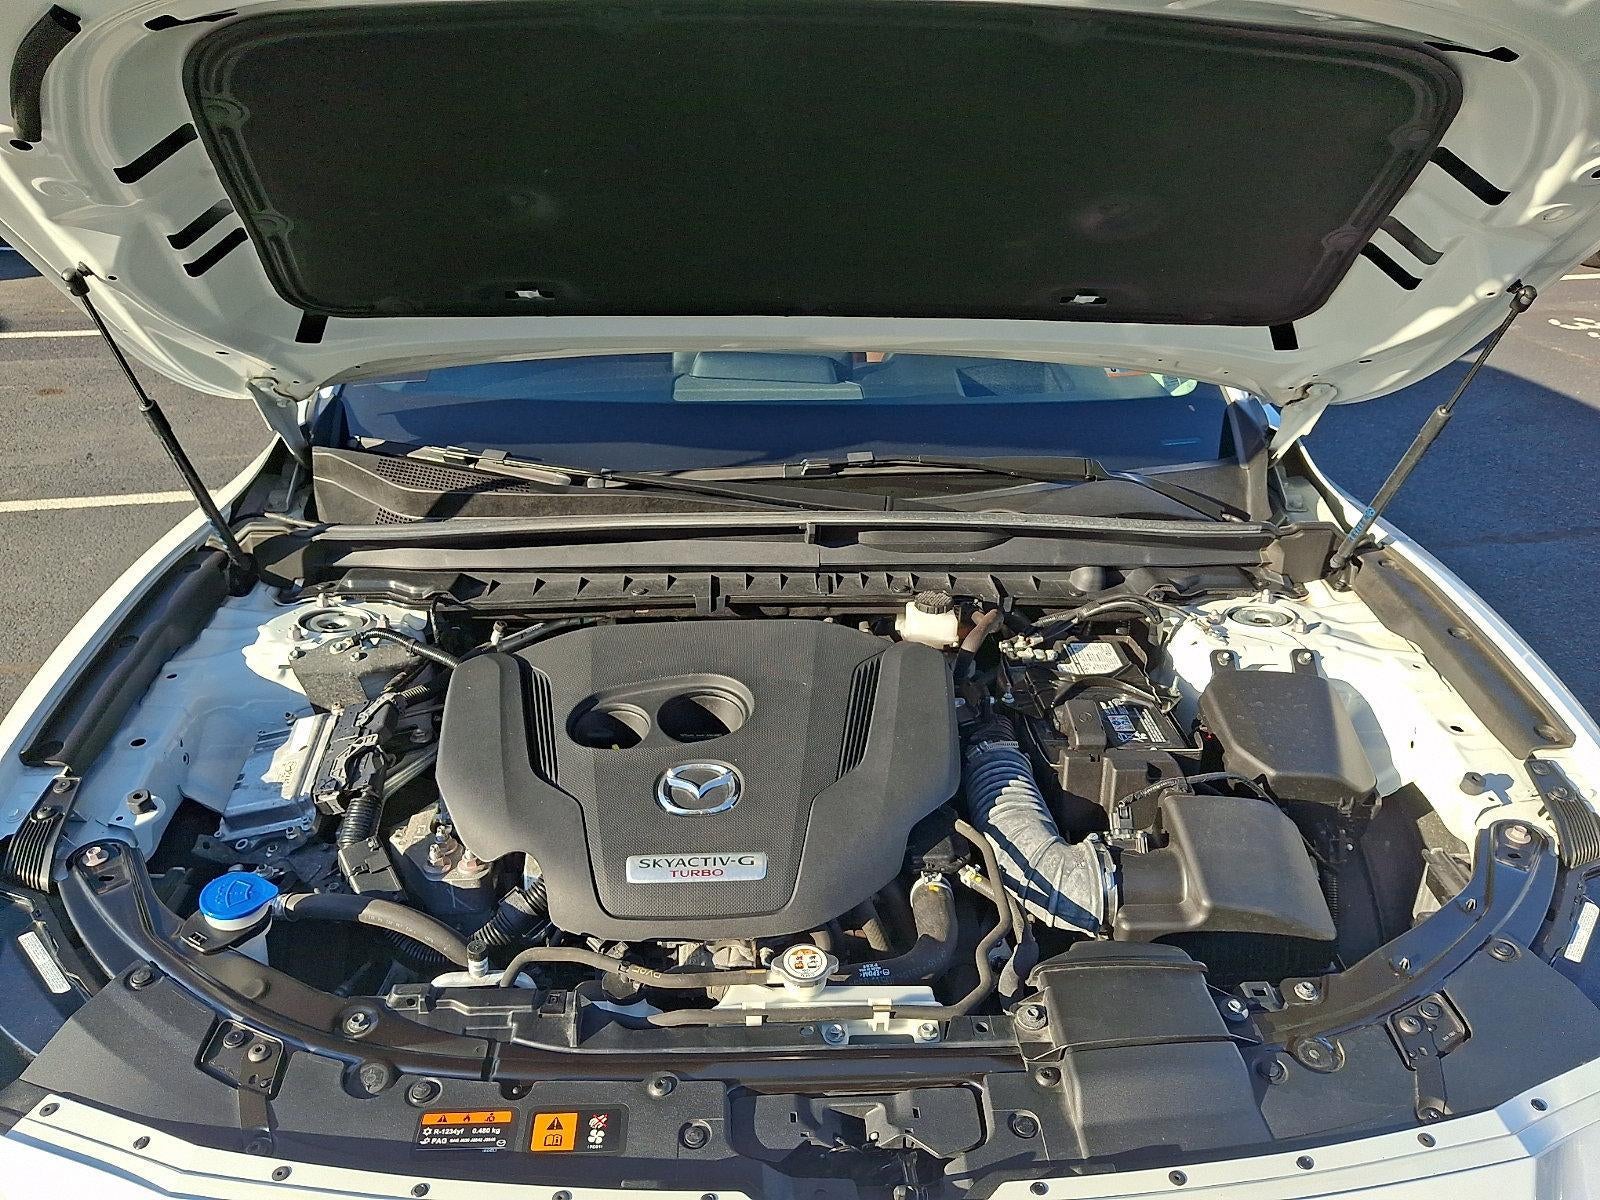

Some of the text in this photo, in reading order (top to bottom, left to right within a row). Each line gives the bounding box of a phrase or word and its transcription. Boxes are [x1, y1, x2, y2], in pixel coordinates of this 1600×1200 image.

[638, 855, 755, 869] SKYACTIV-G
[670, 869, 724, 878] TURBO
[433, 1127, 465, 1136] R-1234yf
[491, 1127, 501, 1135] kg
